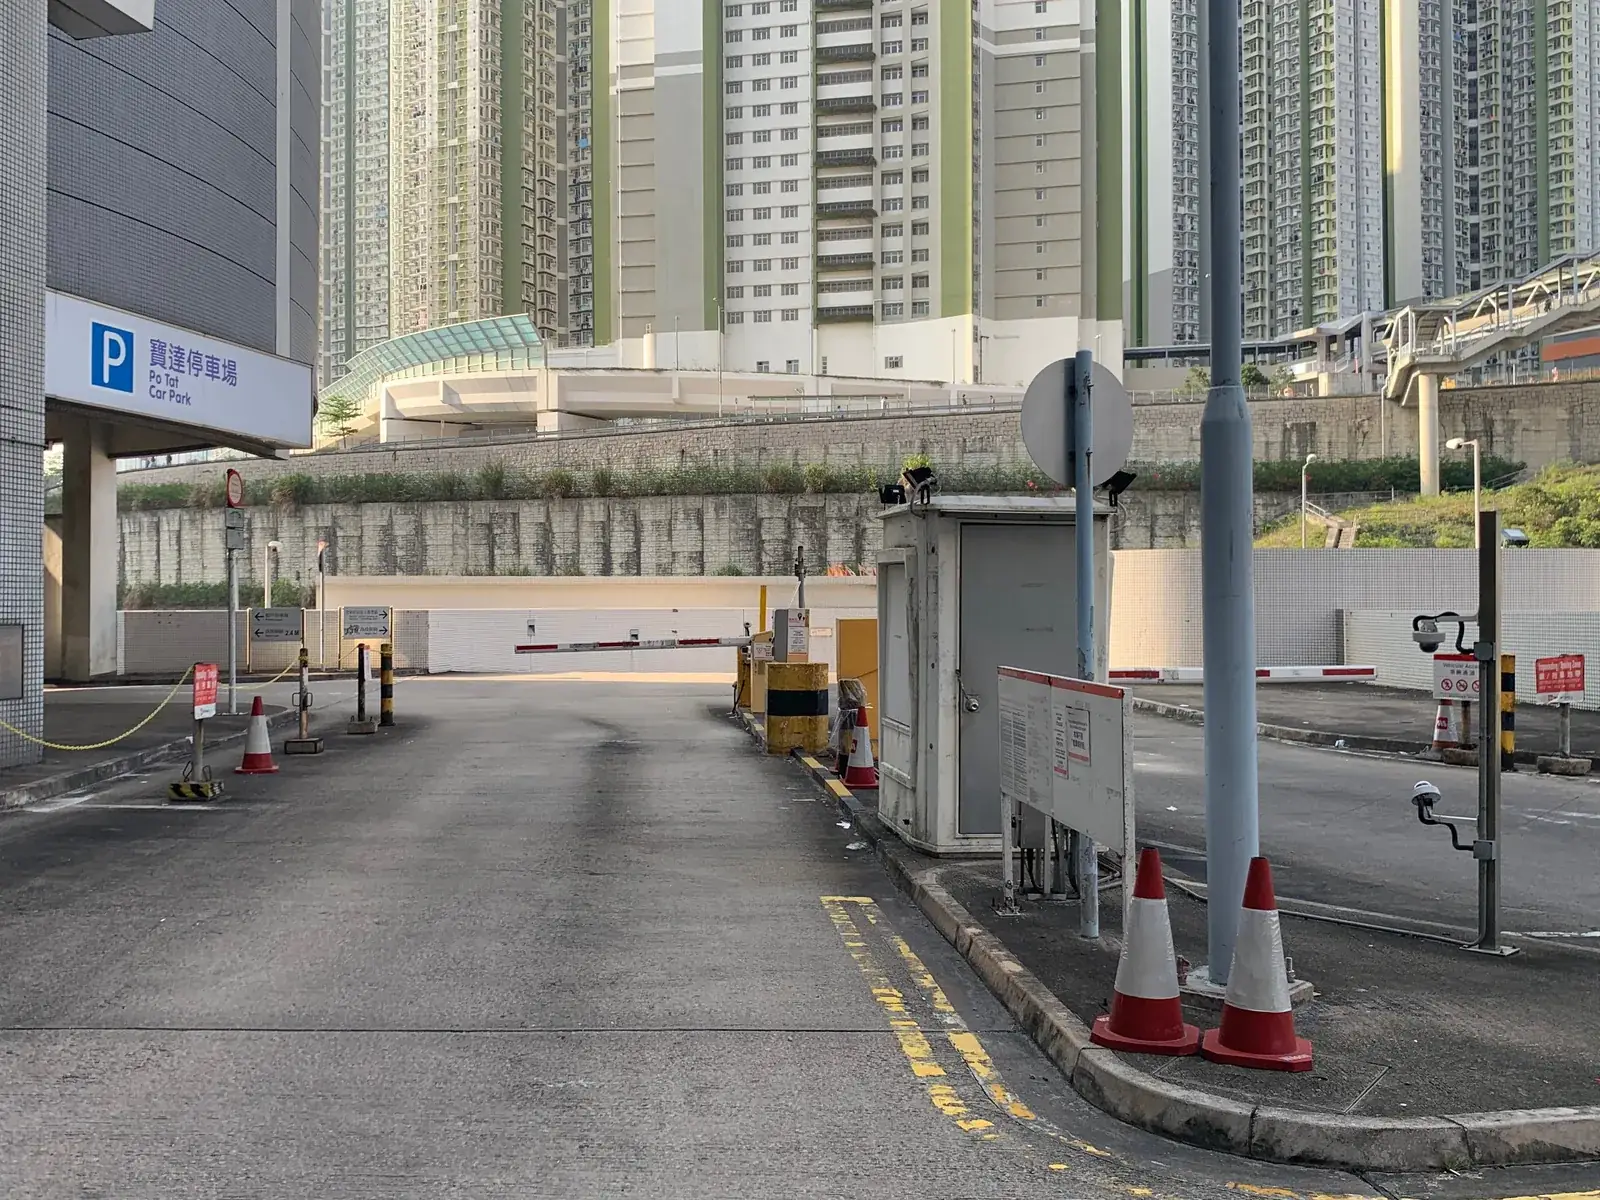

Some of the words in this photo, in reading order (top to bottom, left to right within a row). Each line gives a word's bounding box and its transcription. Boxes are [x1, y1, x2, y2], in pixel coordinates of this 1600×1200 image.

[103, 330, 126, 384] P
[149, 338, 238, 387] 寶達停車場
[149, 370, 162, 383] Po
[165, 373, 179, 388] Tat
[149, 385, 166, 400] Car
[169, 388, 191, 406] Park
